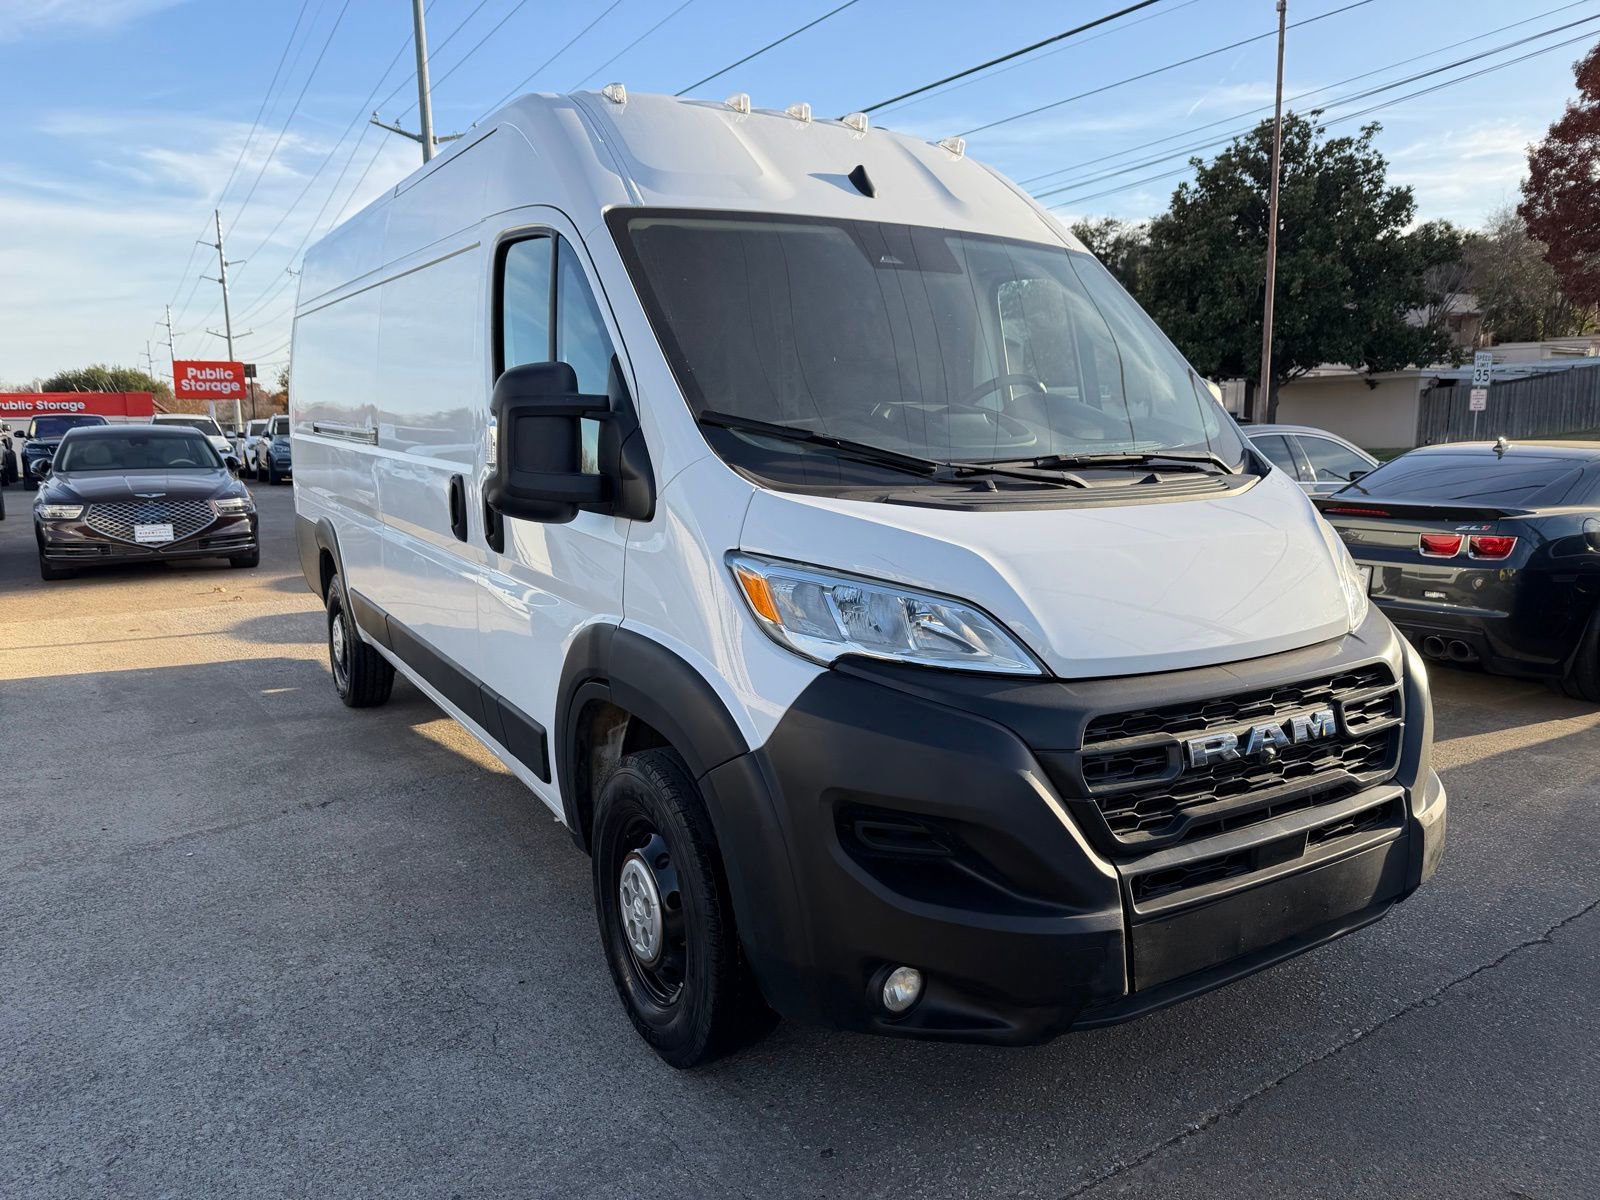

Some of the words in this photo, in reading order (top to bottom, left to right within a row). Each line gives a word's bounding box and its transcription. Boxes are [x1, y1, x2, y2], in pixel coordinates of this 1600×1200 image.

[187, 367, 234, 379] Public
[1475, 369, 1490, 381] 35
[181, 379, 240, 394] Storage
[0, 401, 33, 410] ublic
[36, 401, 86, 412] Storage
[1187, 709, 1337, 768] RAM
